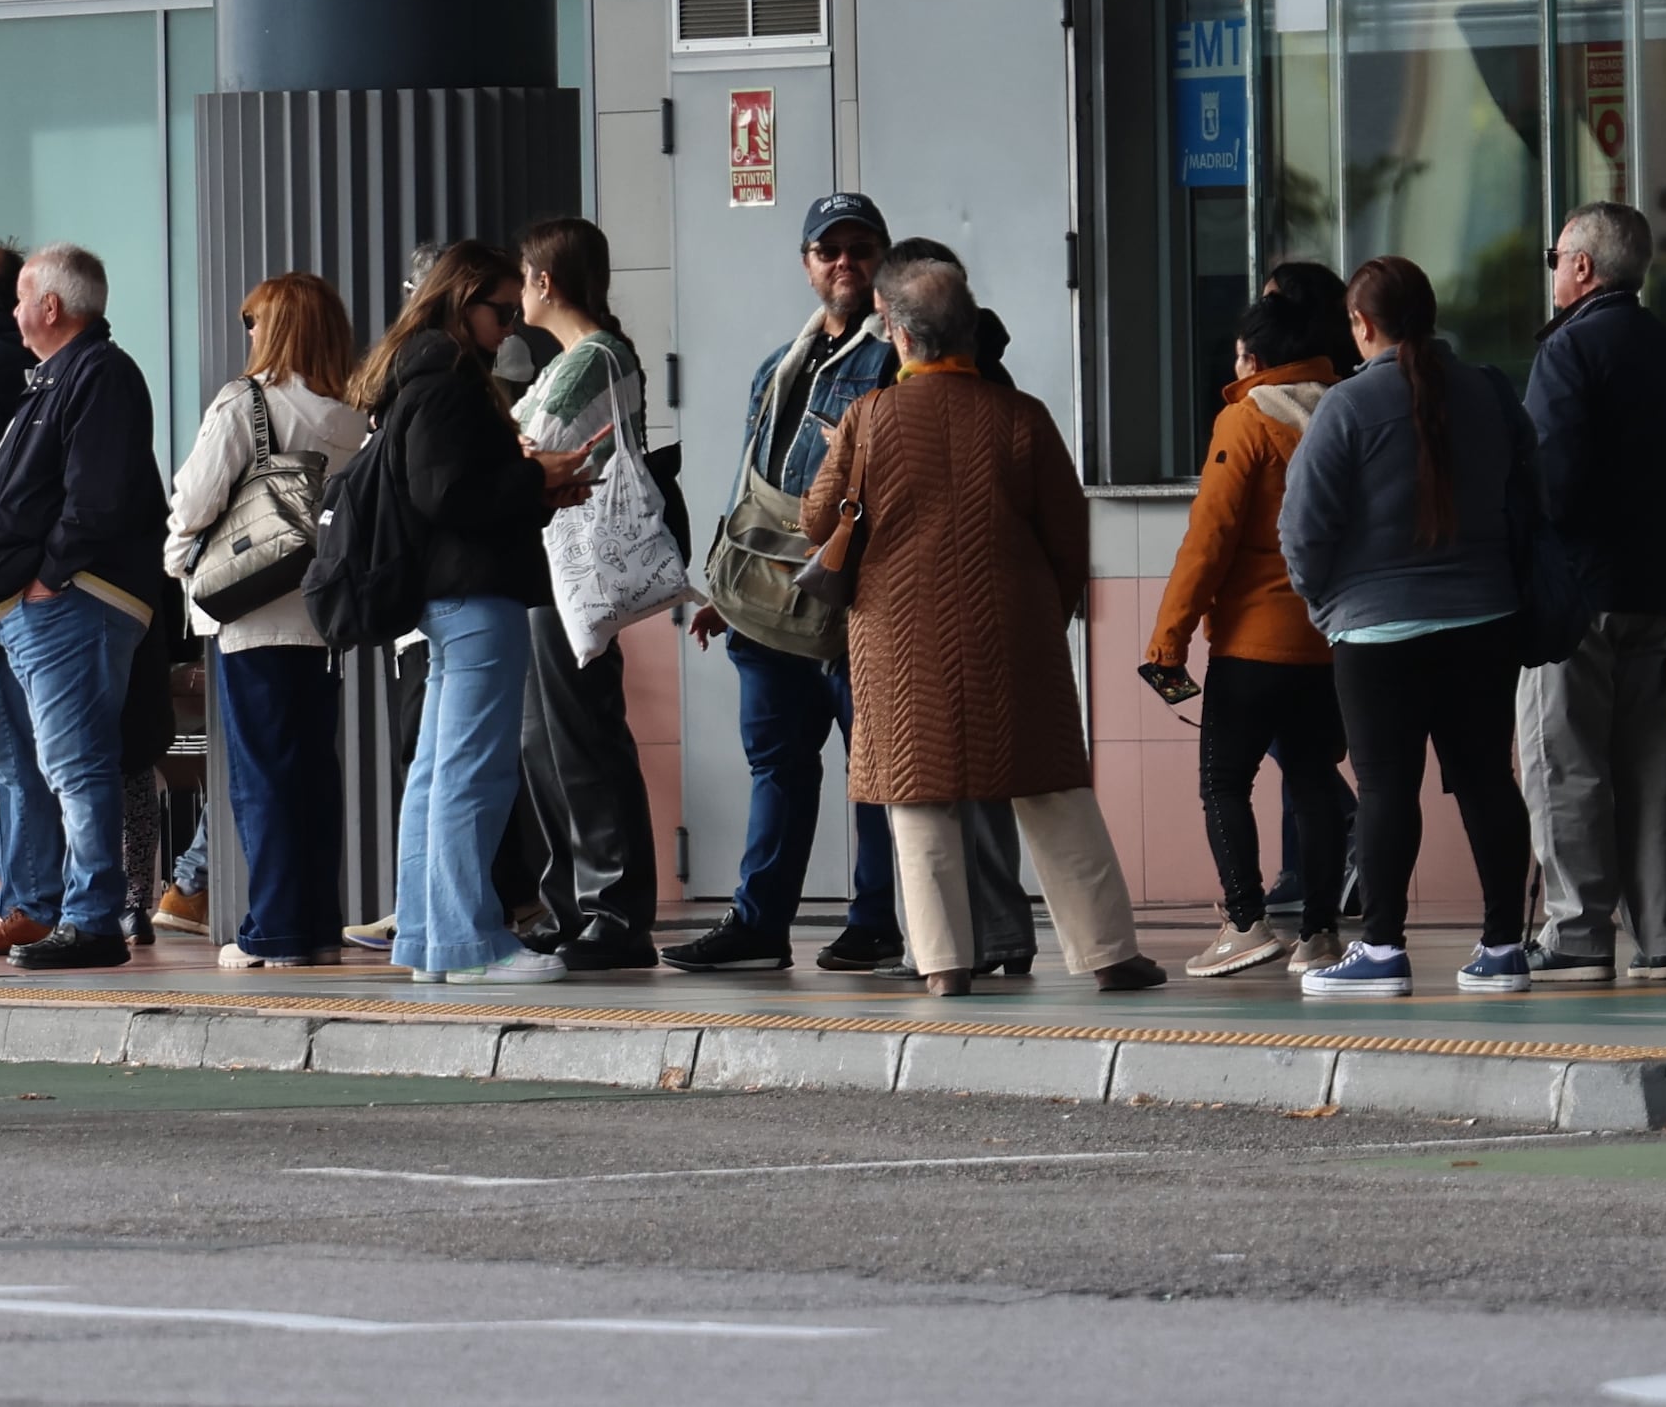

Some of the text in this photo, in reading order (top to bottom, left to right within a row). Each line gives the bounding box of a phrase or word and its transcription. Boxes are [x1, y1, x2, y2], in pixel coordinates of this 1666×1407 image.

[1175, 18, 1247, 68] EMT
[1183, 138, 1240, 182] ¡MADRID!
[733, 172, 772, 186] EXTINTOR
[739, 187, 765, 201] MOVIL
